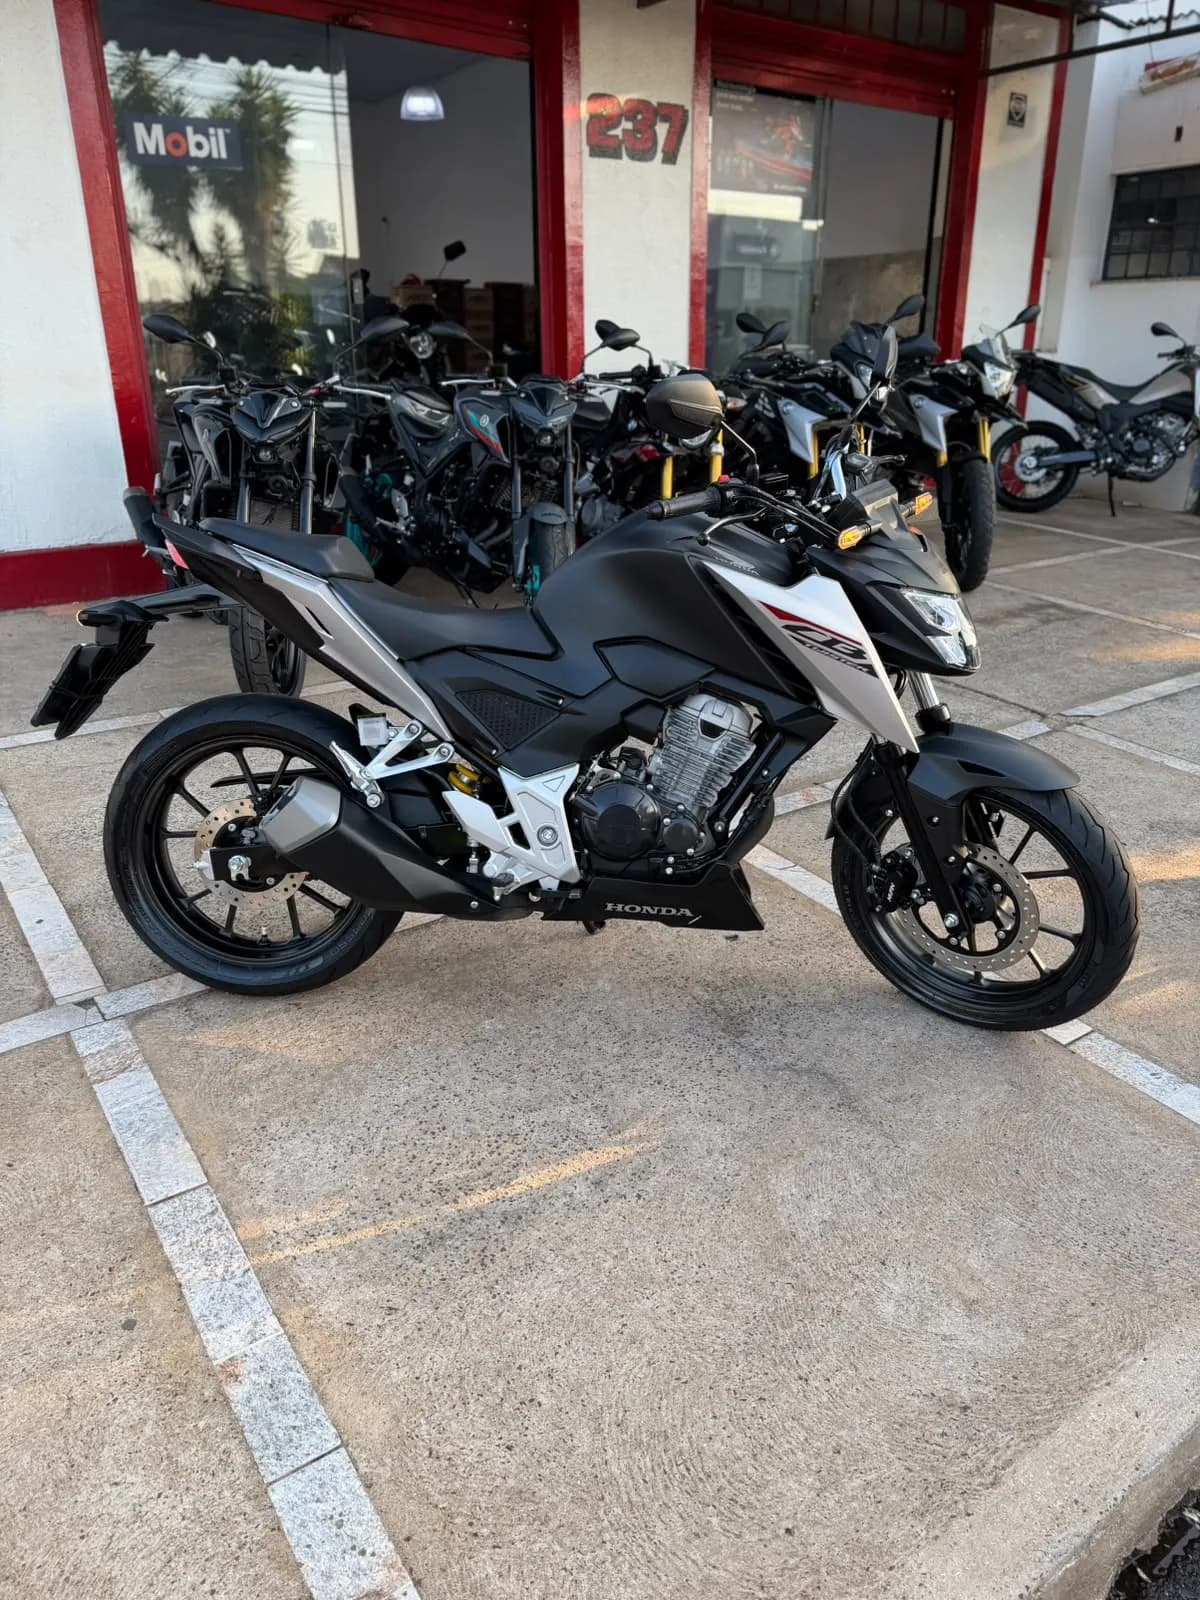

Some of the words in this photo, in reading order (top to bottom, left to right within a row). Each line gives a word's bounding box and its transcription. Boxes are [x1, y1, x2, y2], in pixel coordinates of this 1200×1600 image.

[133, 122, 227, 159] Mobil
[586, 93, 688, 165] 237
[605, 902, 695, 917] HONDA
